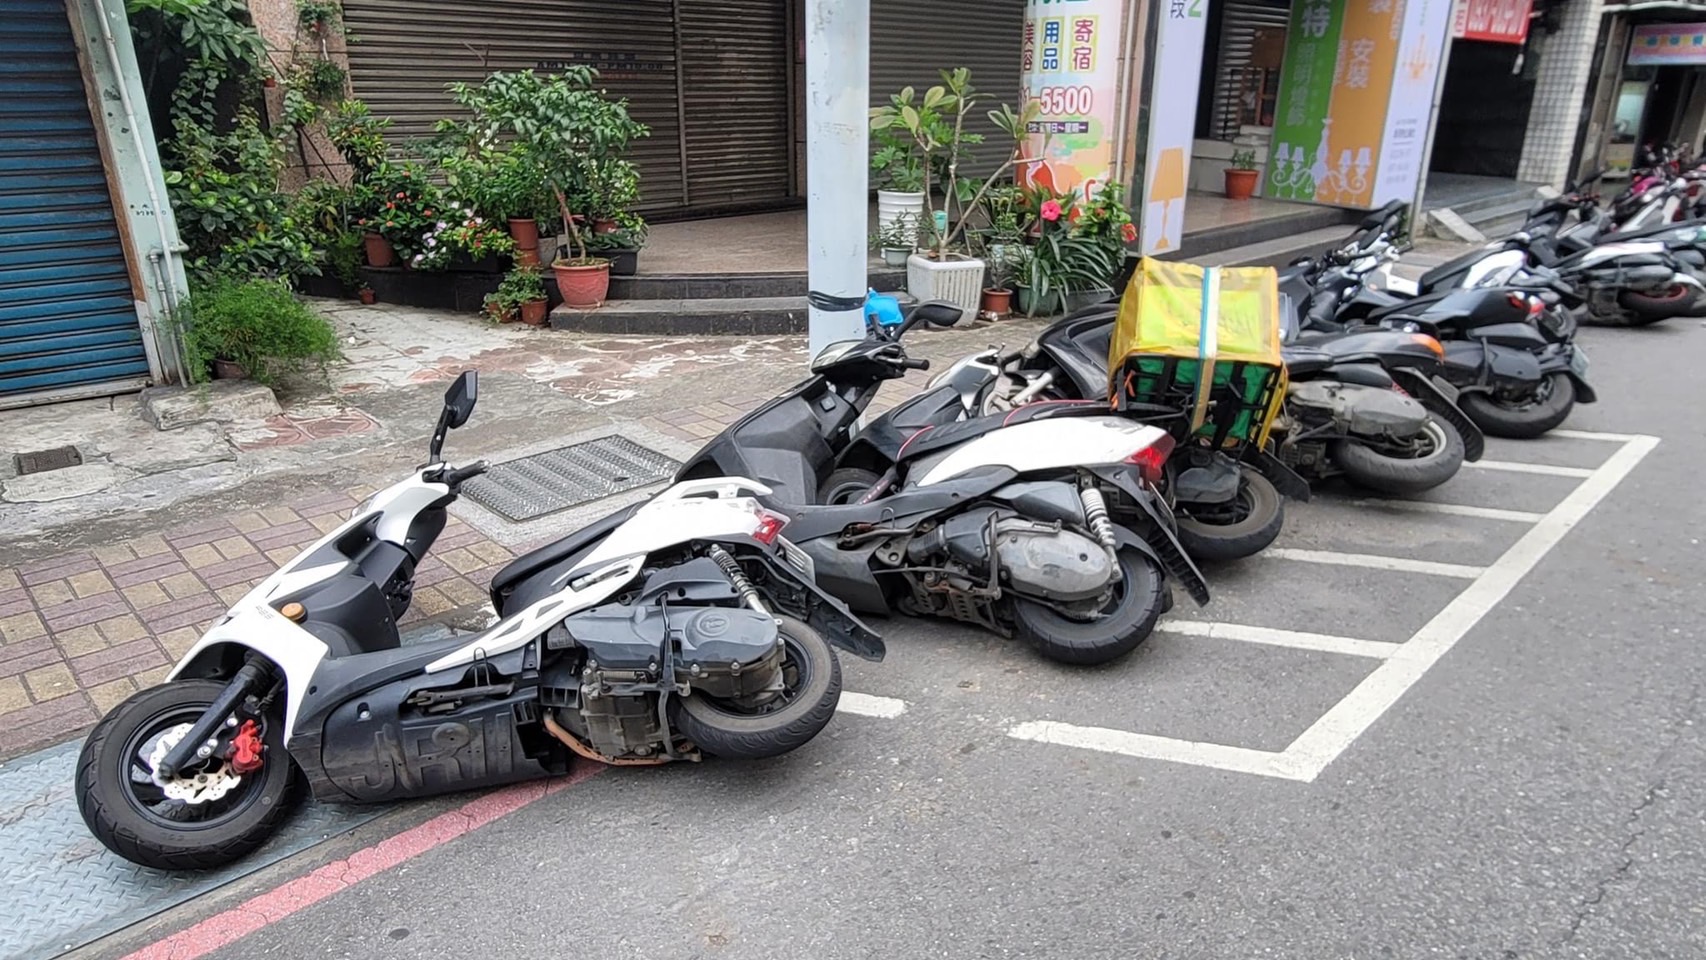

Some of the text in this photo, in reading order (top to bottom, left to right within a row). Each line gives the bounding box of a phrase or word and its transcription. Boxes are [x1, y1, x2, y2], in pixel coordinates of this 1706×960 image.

[1042, 21, 1060, 70] 用品
[1073, 19, 1094, 70] 寄宿
[1301, 5, 1331, 38] 特
[1347, 38, 1375, 88] 安裝
